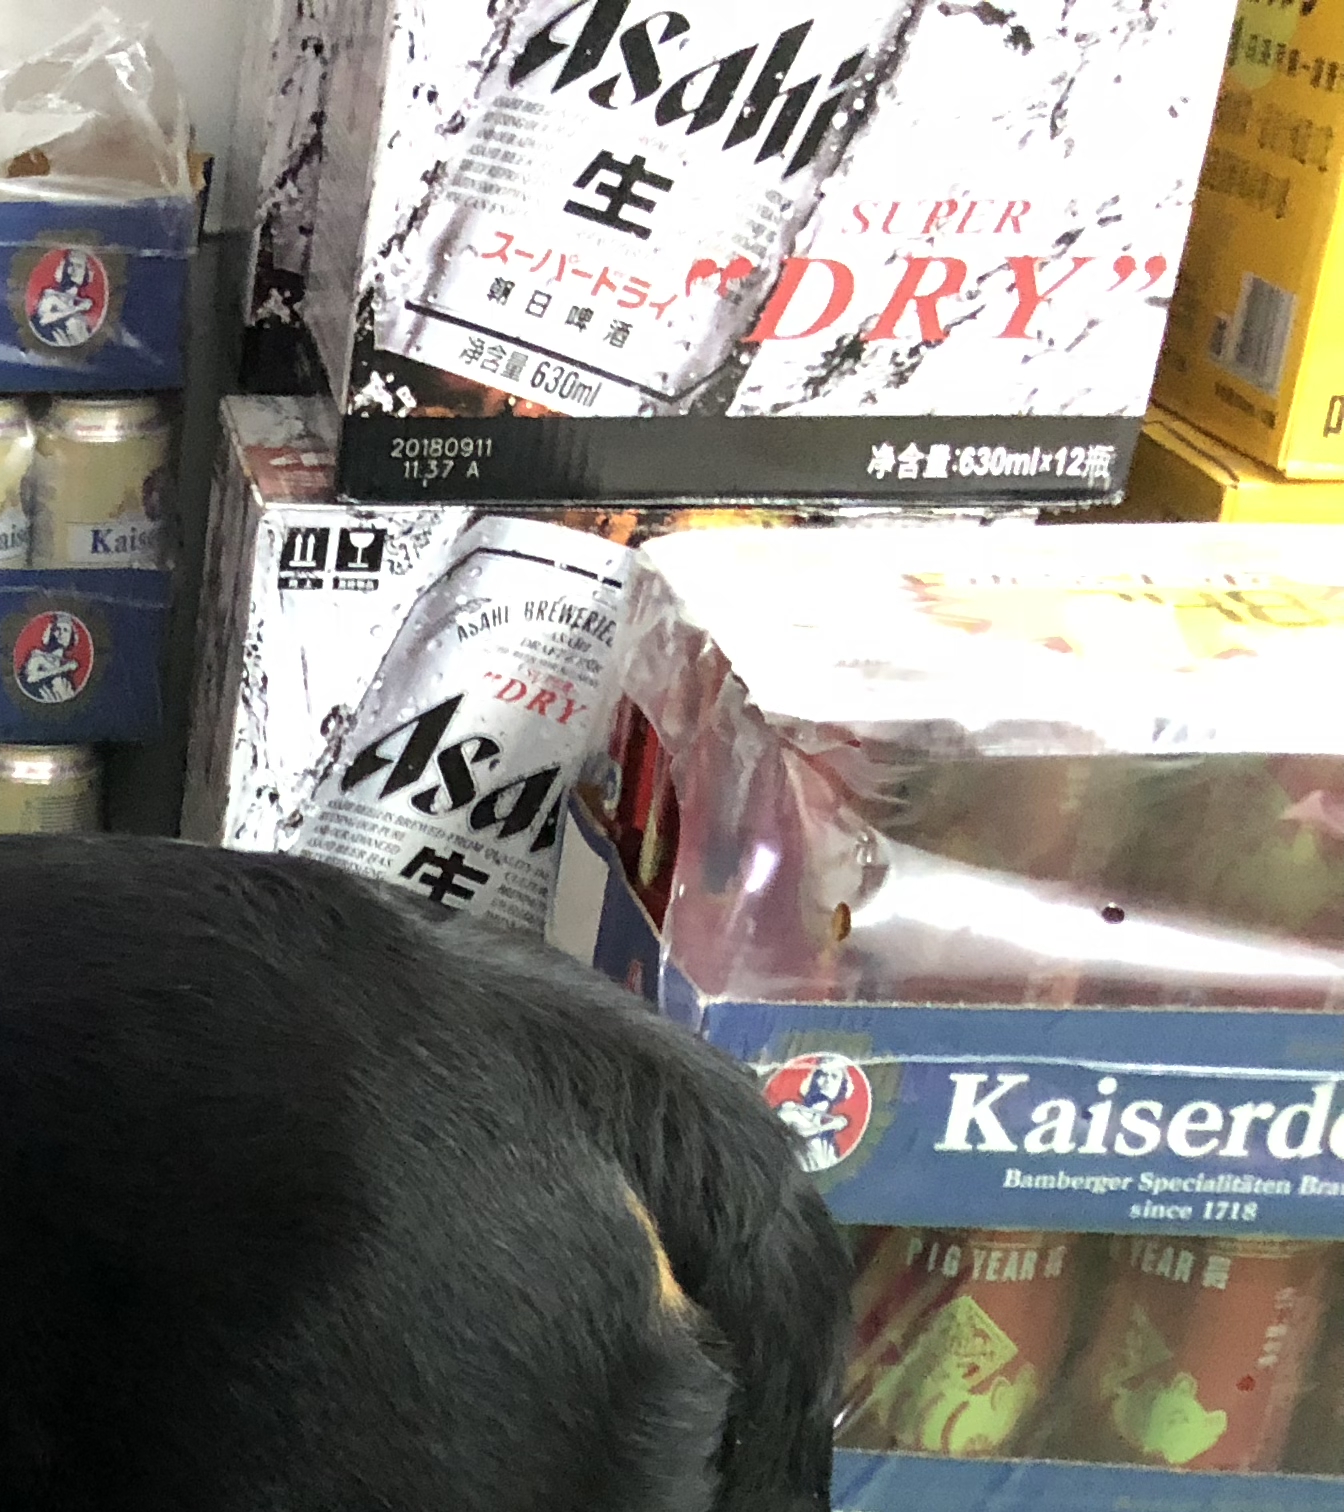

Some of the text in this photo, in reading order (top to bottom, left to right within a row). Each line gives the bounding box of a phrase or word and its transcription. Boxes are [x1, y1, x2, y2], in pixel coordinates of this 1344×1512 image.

[563, 149, 675, 240] 生
[842, 199, 1032, 235] SUPER
[480, 230, 678, 321] スーパードライ
[530, 360, 603, 409] 630ml
[390, 436, 493, 459] 20180911
[466, 460, 480, 478] A
[456, 605, 510, 643] ASAHI
[1003, 1168, 1132, 1195] Bamberger
[1138, 1172, 1291, 1196] Specialitäten
[1129, 1199, 1259, 1222] since 1718
[971, 1244, 1037, 1282] YEAR
